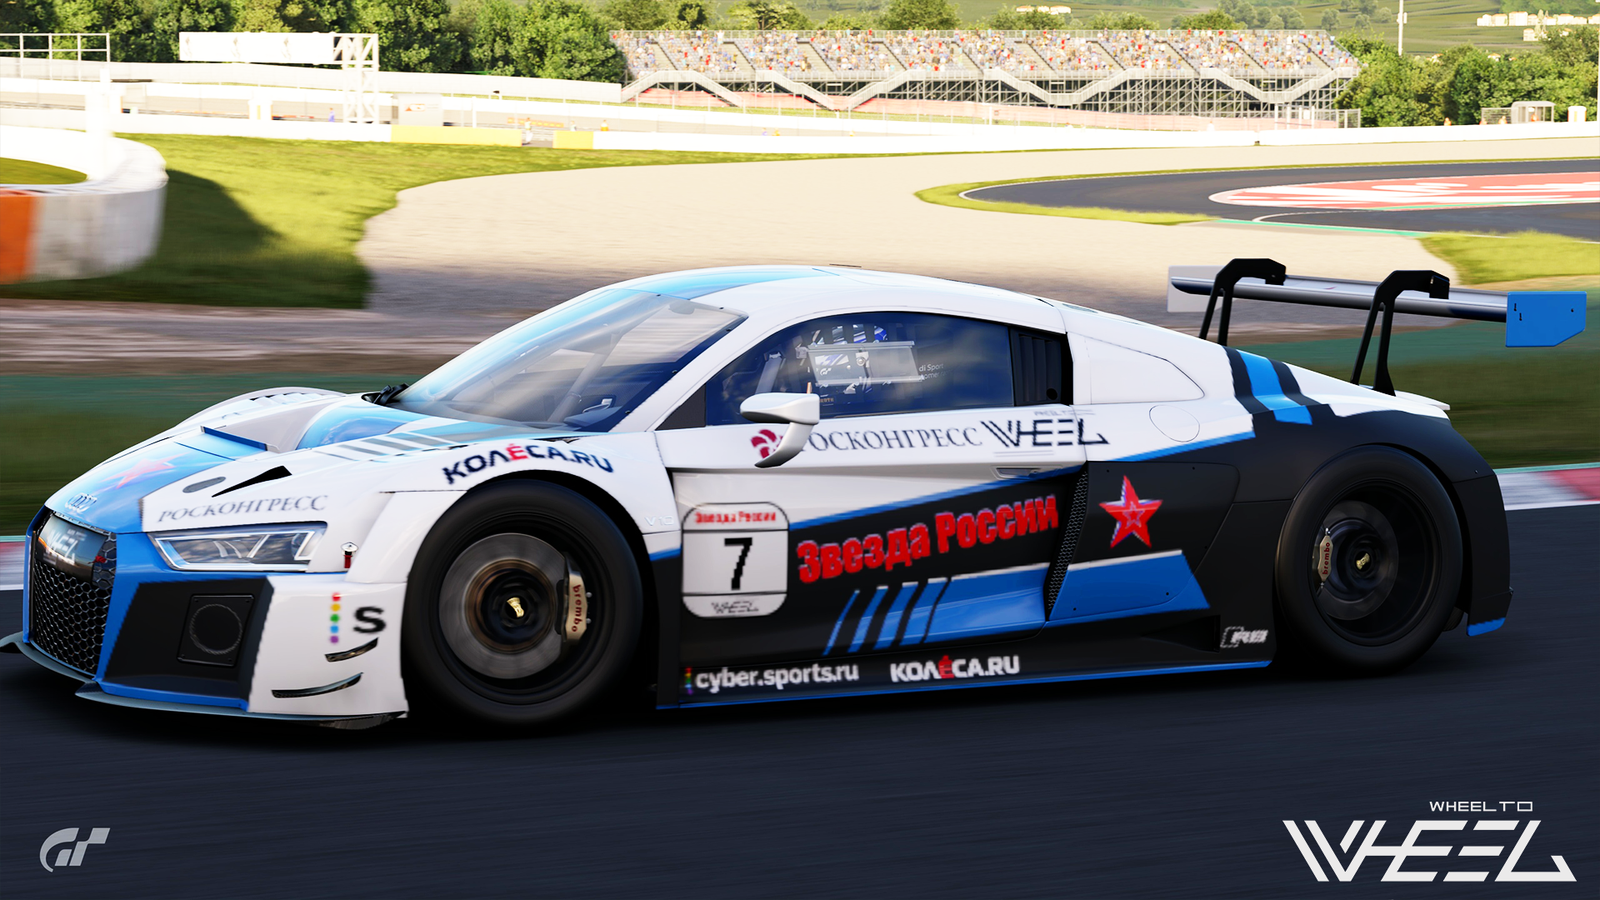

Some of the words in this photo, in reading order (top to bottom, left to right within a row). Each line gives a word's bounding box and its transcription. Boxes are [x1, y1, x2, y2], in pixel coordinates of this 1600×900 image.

[801, 427, 983, 452] ОСКОНГРЕСС
[157, 495, 328, 523] РОСКОНГРЕСС
[797, 522, 931, 584] Звезда
[935, 494, 1060, 554] России
[724, 537, 753, 591] 7
[1322, 541, 1331, 575] brembo
[352, 605, 387, 634] S
[571, 584, 583, 632] brembo
[695, 663, 859, 694] cyber.sports.ru
